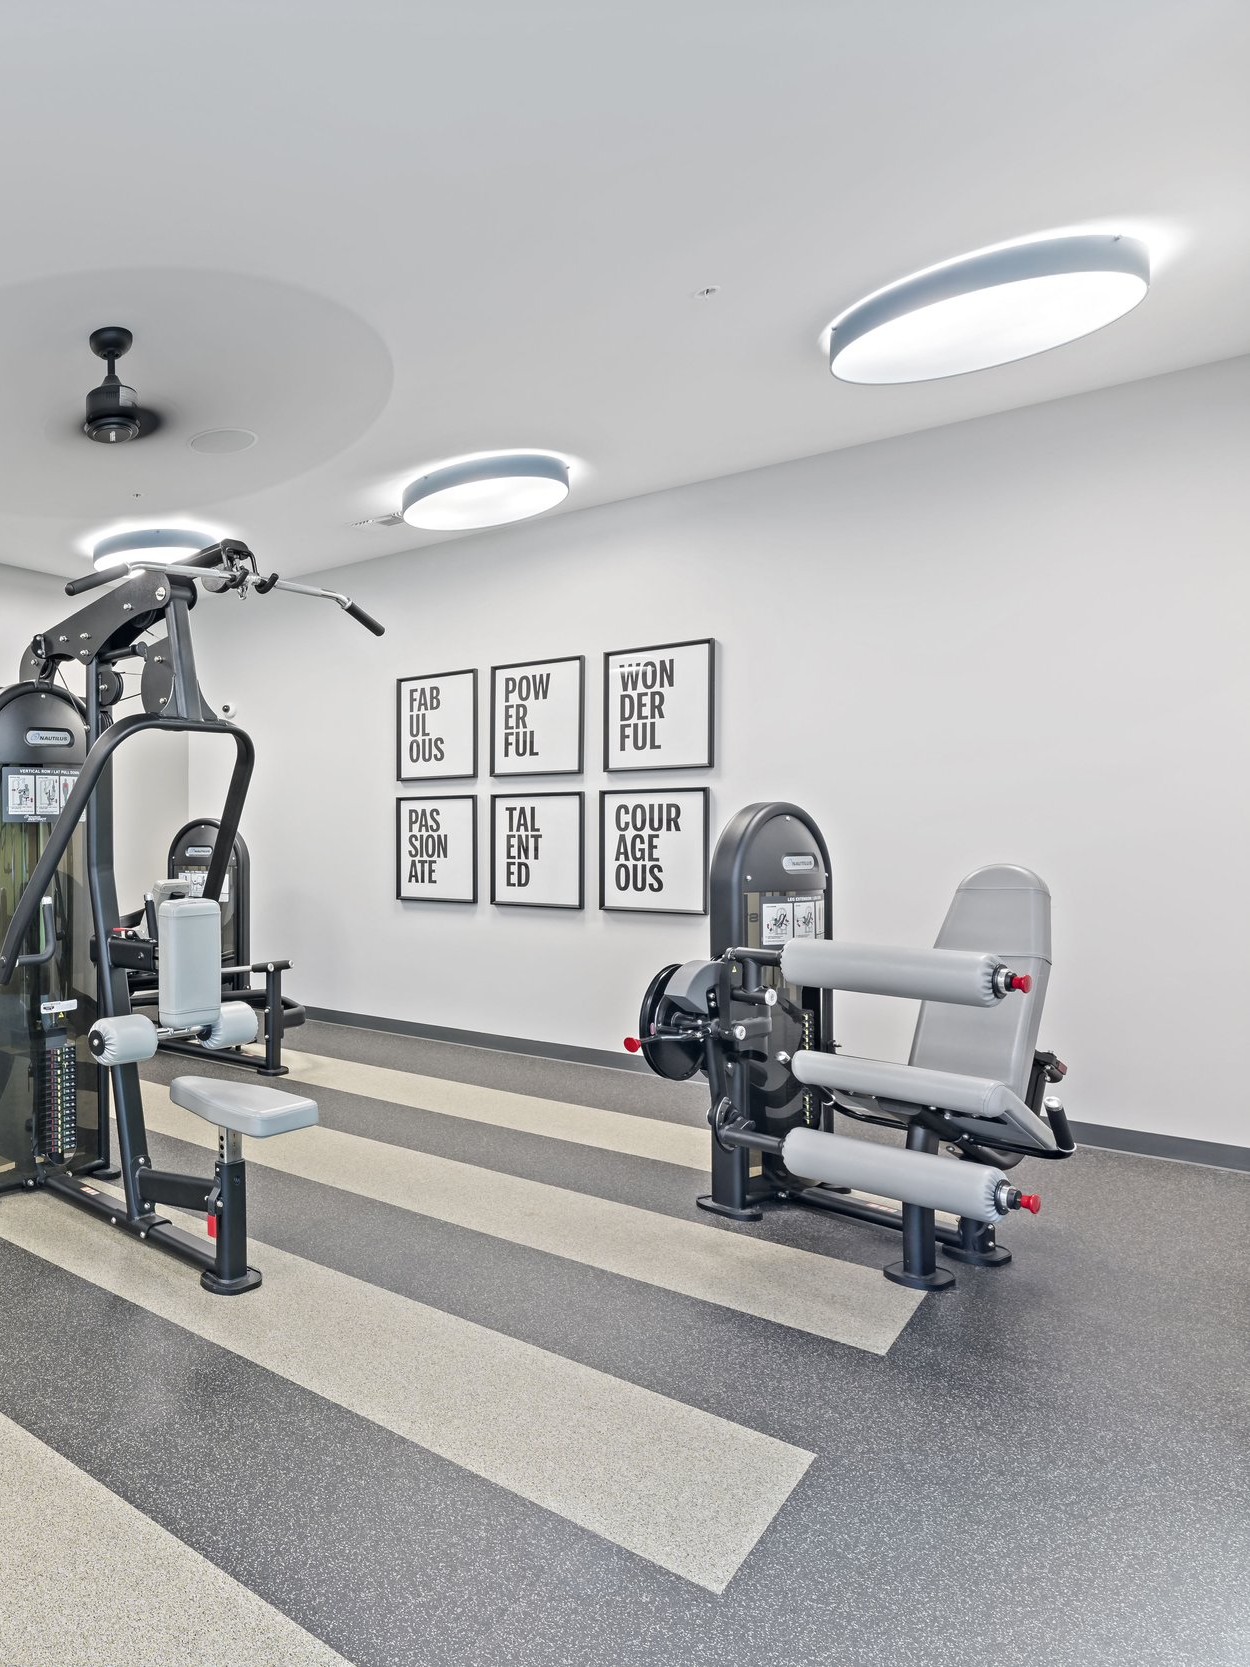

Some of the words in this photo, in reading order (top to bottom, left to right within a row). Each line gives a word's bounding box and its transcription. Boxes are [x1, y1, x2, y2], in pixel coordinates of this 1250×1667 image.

[505, 673, 550, 703] POW
[619, 659, 674, 692] WON
[409, 686, 441, 712] FAB
[620, 691, 665, 721] DER
[409, 713, 430, 738] UL
[504, 704, 528, 731] ER
[409, 737, 445, 763] OUS
[504, 731, 539, 758] FUL
[620, 722, 661, 752] FUL
[408, 808, 440, 833] PAS
[506, 806, 540, 833] TAL
[615, 803, 681, 832] COUR
[408, 834, 448, 858] SION
[506, 834, 542, 861] ENT
[615, 833, 660, 863] AGE
[408, 860, 437, 884] ATE
[506, 861, 530, 888] ED
[615, 863, 664, 893] OUS
